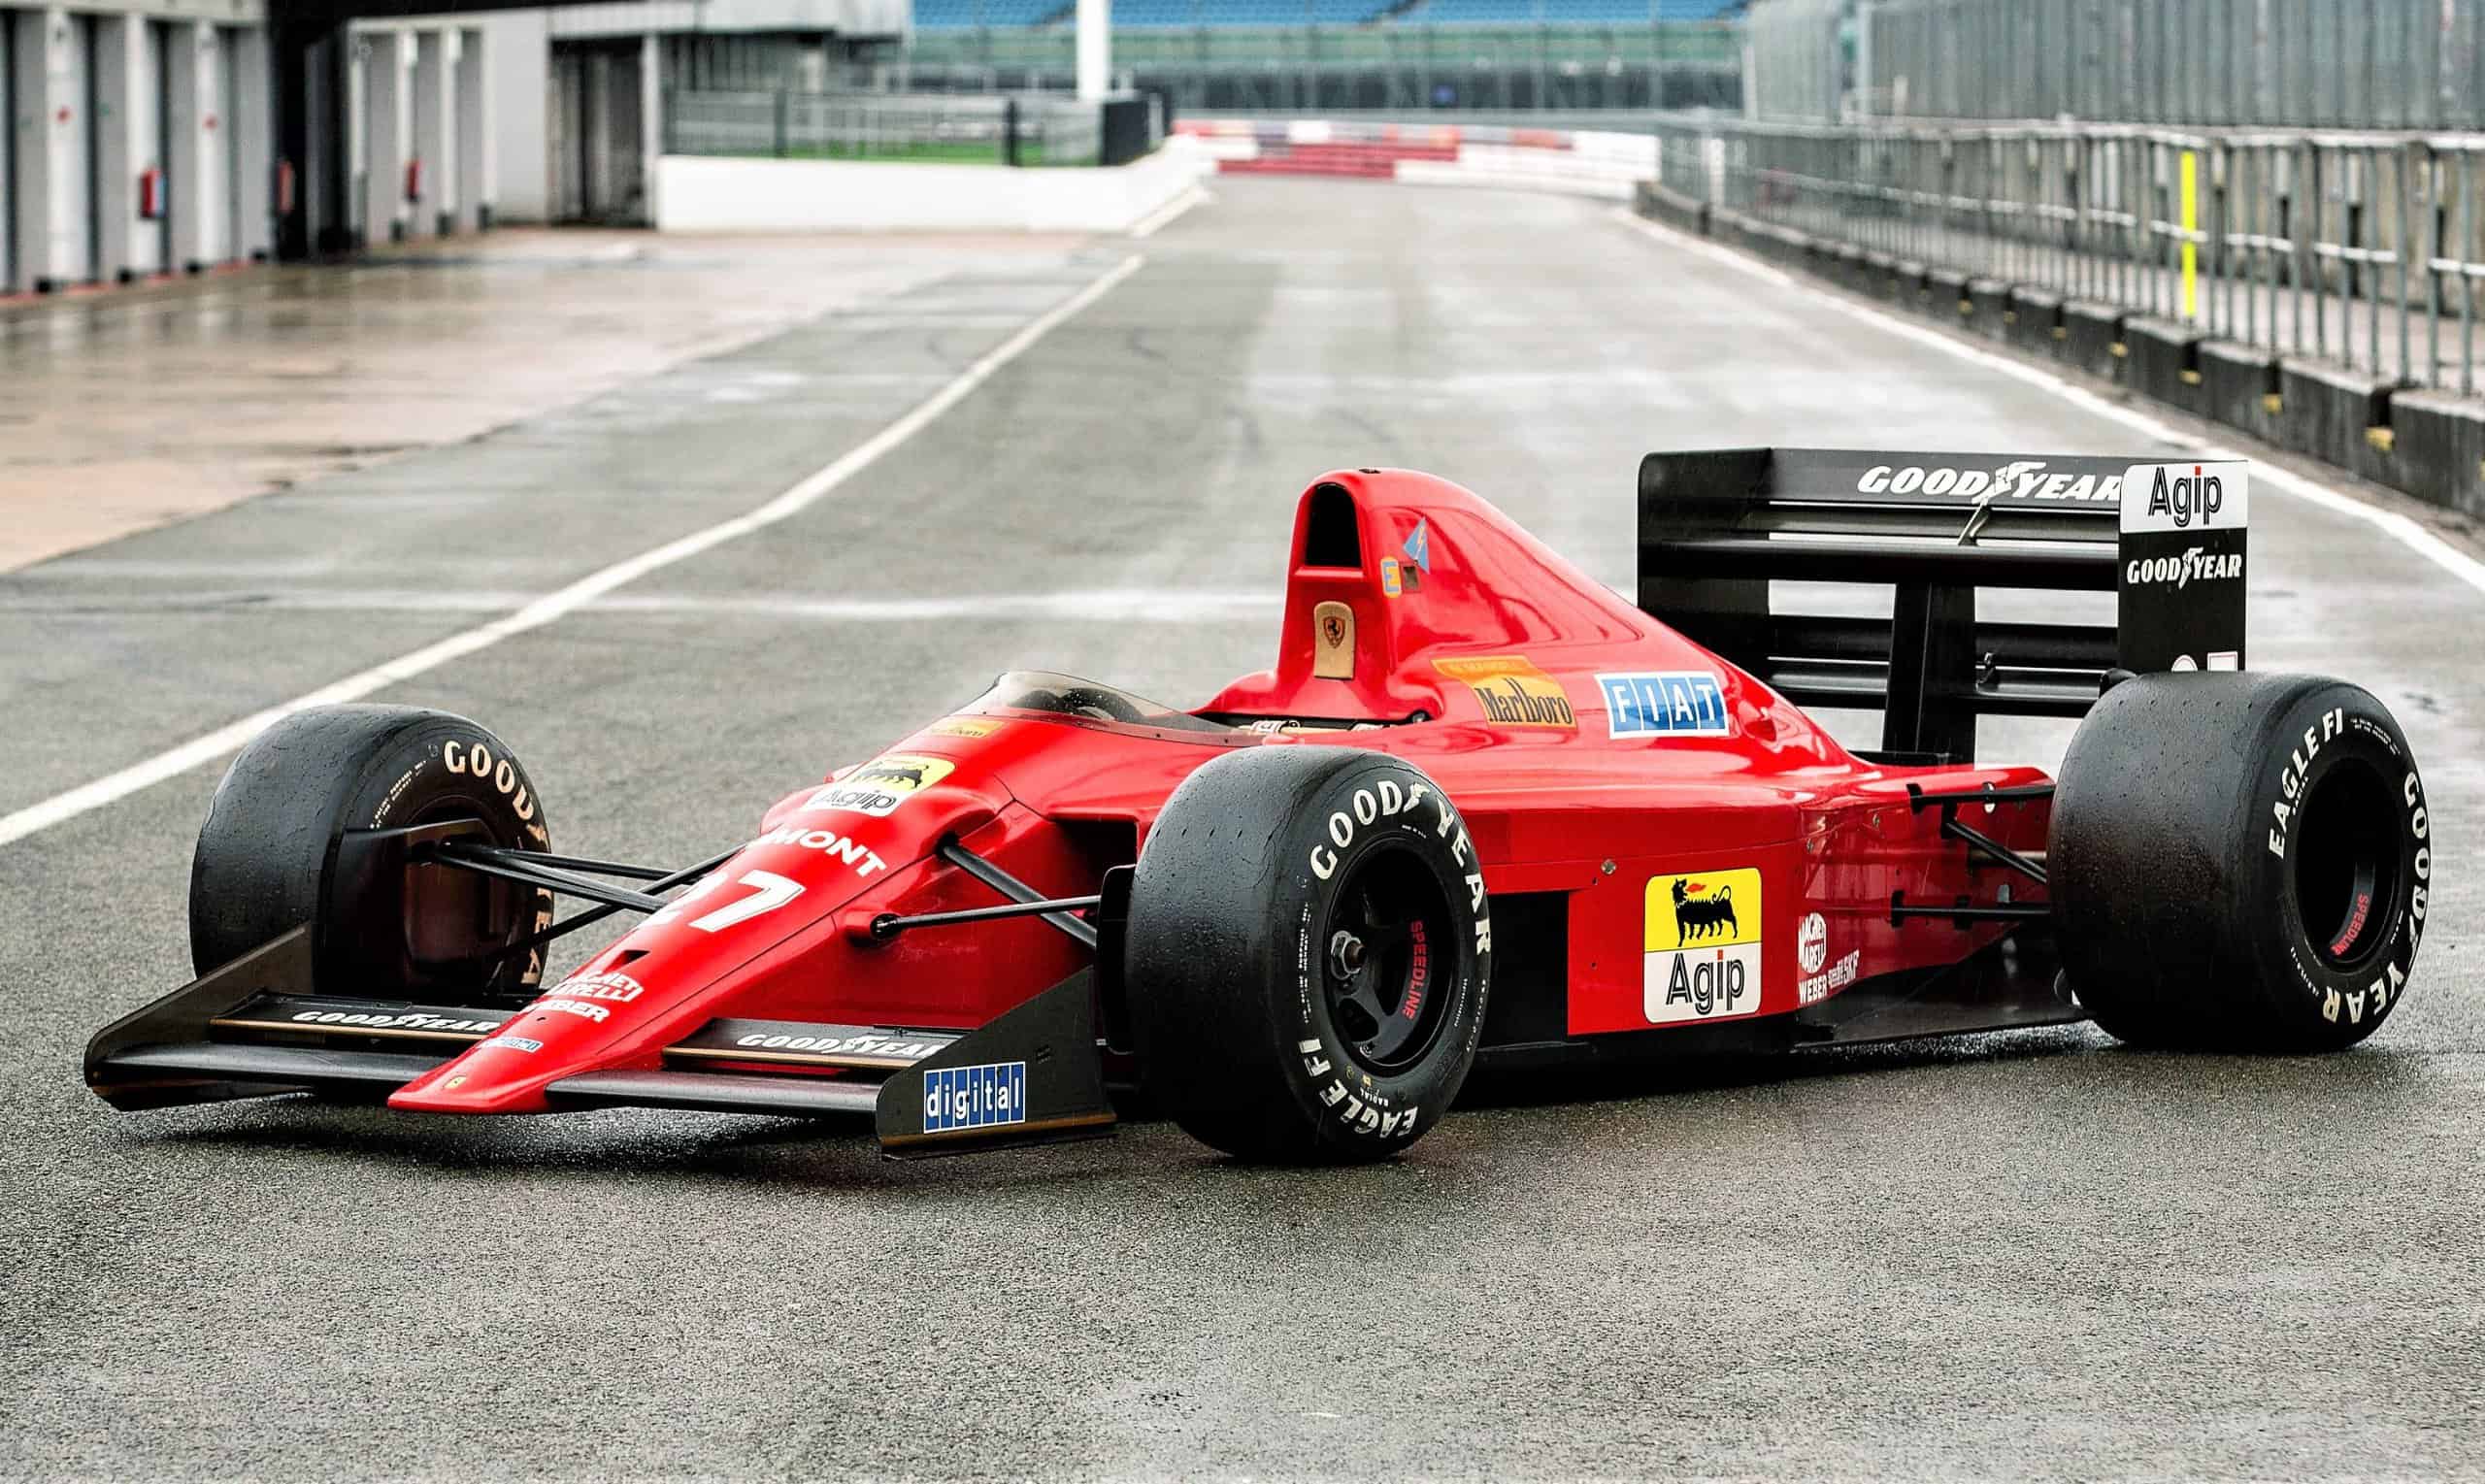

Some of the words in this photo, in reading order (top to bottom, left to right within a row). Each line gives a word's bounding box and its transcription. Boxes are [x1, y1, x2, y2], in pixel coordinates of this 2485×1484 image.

[2147, 466, 2223, 527] Agip
[1474, 677, 1574, 724] Marlboro
[1613, 681, 1720, 724] FIAT
[2269, 725, 2320, 859] EAGLE
[1403, 920, 1429, 1020] SPEEDLINE
[1666, 948, 1745, 1015] Agip
[926, 1075, 1020, 1120] digital
[1319, 1078, 1418, 1138] EAGLE
